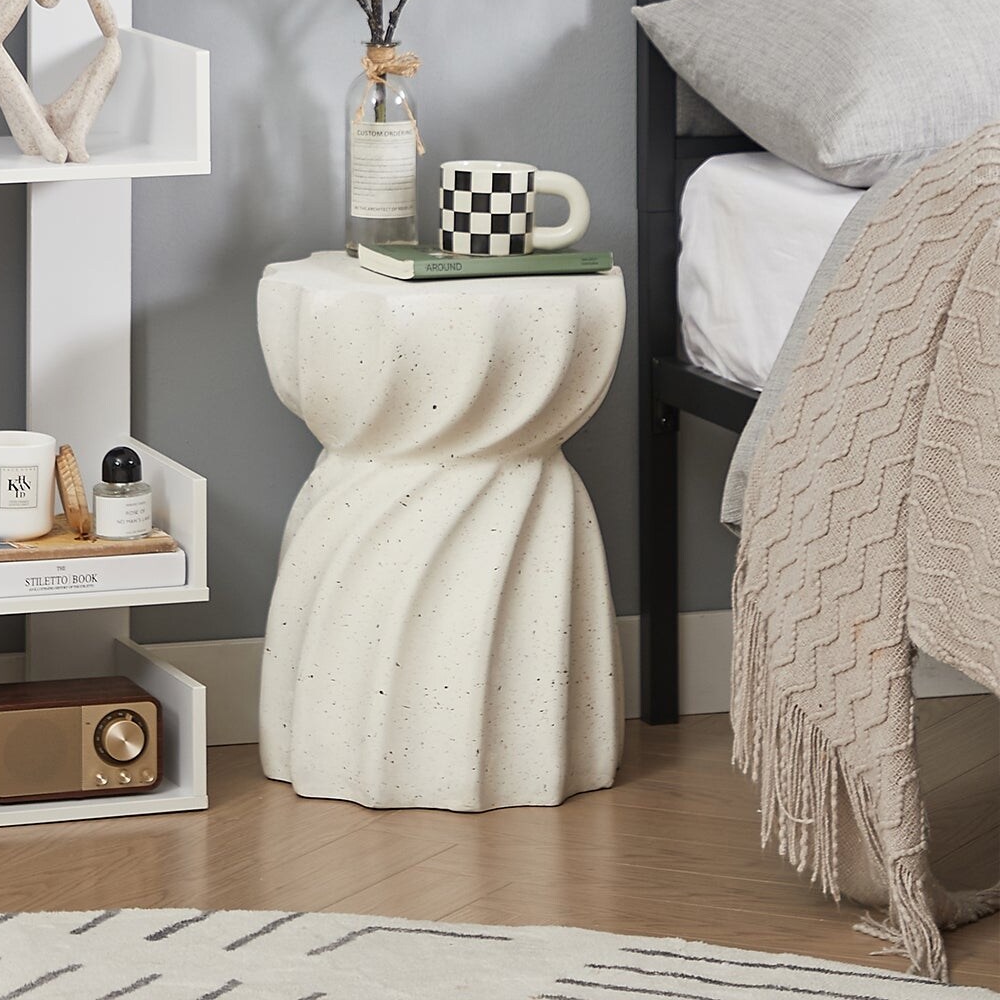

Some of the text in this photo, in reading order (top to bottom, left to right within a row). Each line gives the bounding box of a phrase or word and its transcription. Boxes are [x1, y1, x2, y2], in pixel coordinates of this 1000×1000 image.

[426, 262, 462, 272] AROUND
[25, 574, 98, 586] STILETTO BOOK
